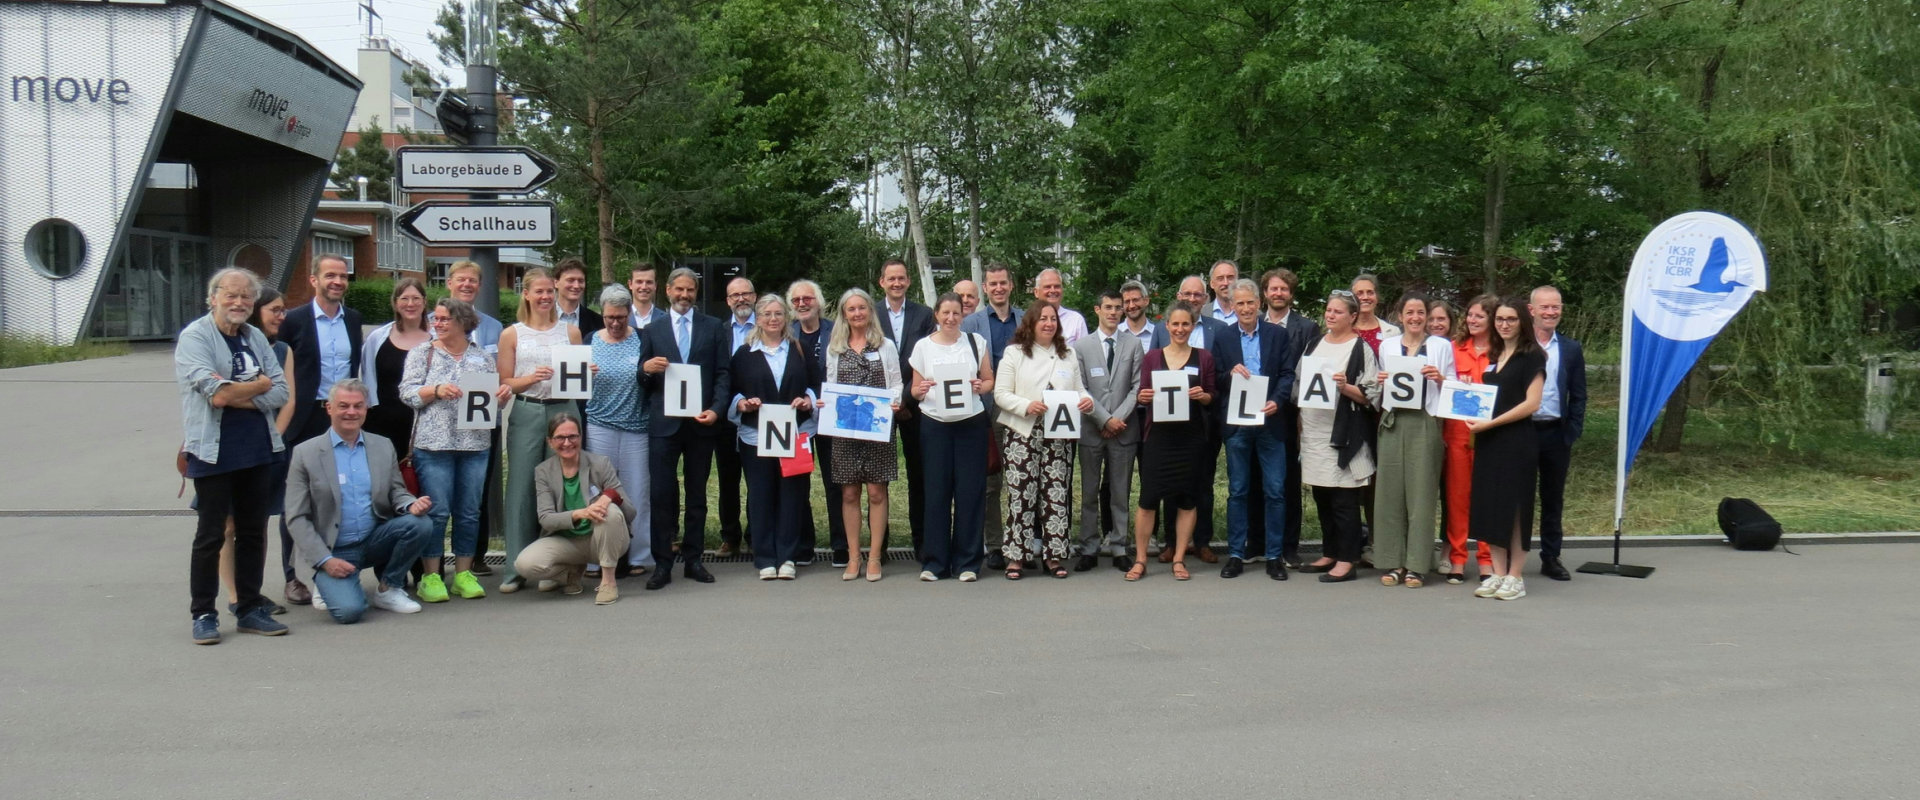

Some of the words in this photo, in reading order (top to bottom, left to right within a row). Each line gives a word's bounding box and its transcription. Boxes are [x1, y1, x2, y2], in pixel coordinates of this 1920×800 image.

[13, 75, 130, 105] move
[248, 87, 289, 120] move
[412, 164, 509, 178] Laborgebäude
[513, 164, 523, 176] B
[439, 216, 537, 231] Schallhaus
[1667, 255, 1694, 266] CIPR
[1669, 245, 1696, 256] IKSR
[1665, 266, 1692, 277] ICBR
[559, 361, 588, 392] H
[1303, 373, 1330, 402] A
[1390, 372, 1415, 402] S
[466, 390, 492, 422] R
[680, 380, 688, 410] I
[943, 379, 965, 410] E
[1160, 386, 1182, 415] T
[1238, 390, 1257, 419] L
[1049, 403, 1076, 432] A
[765, 420, 792, 451] N
